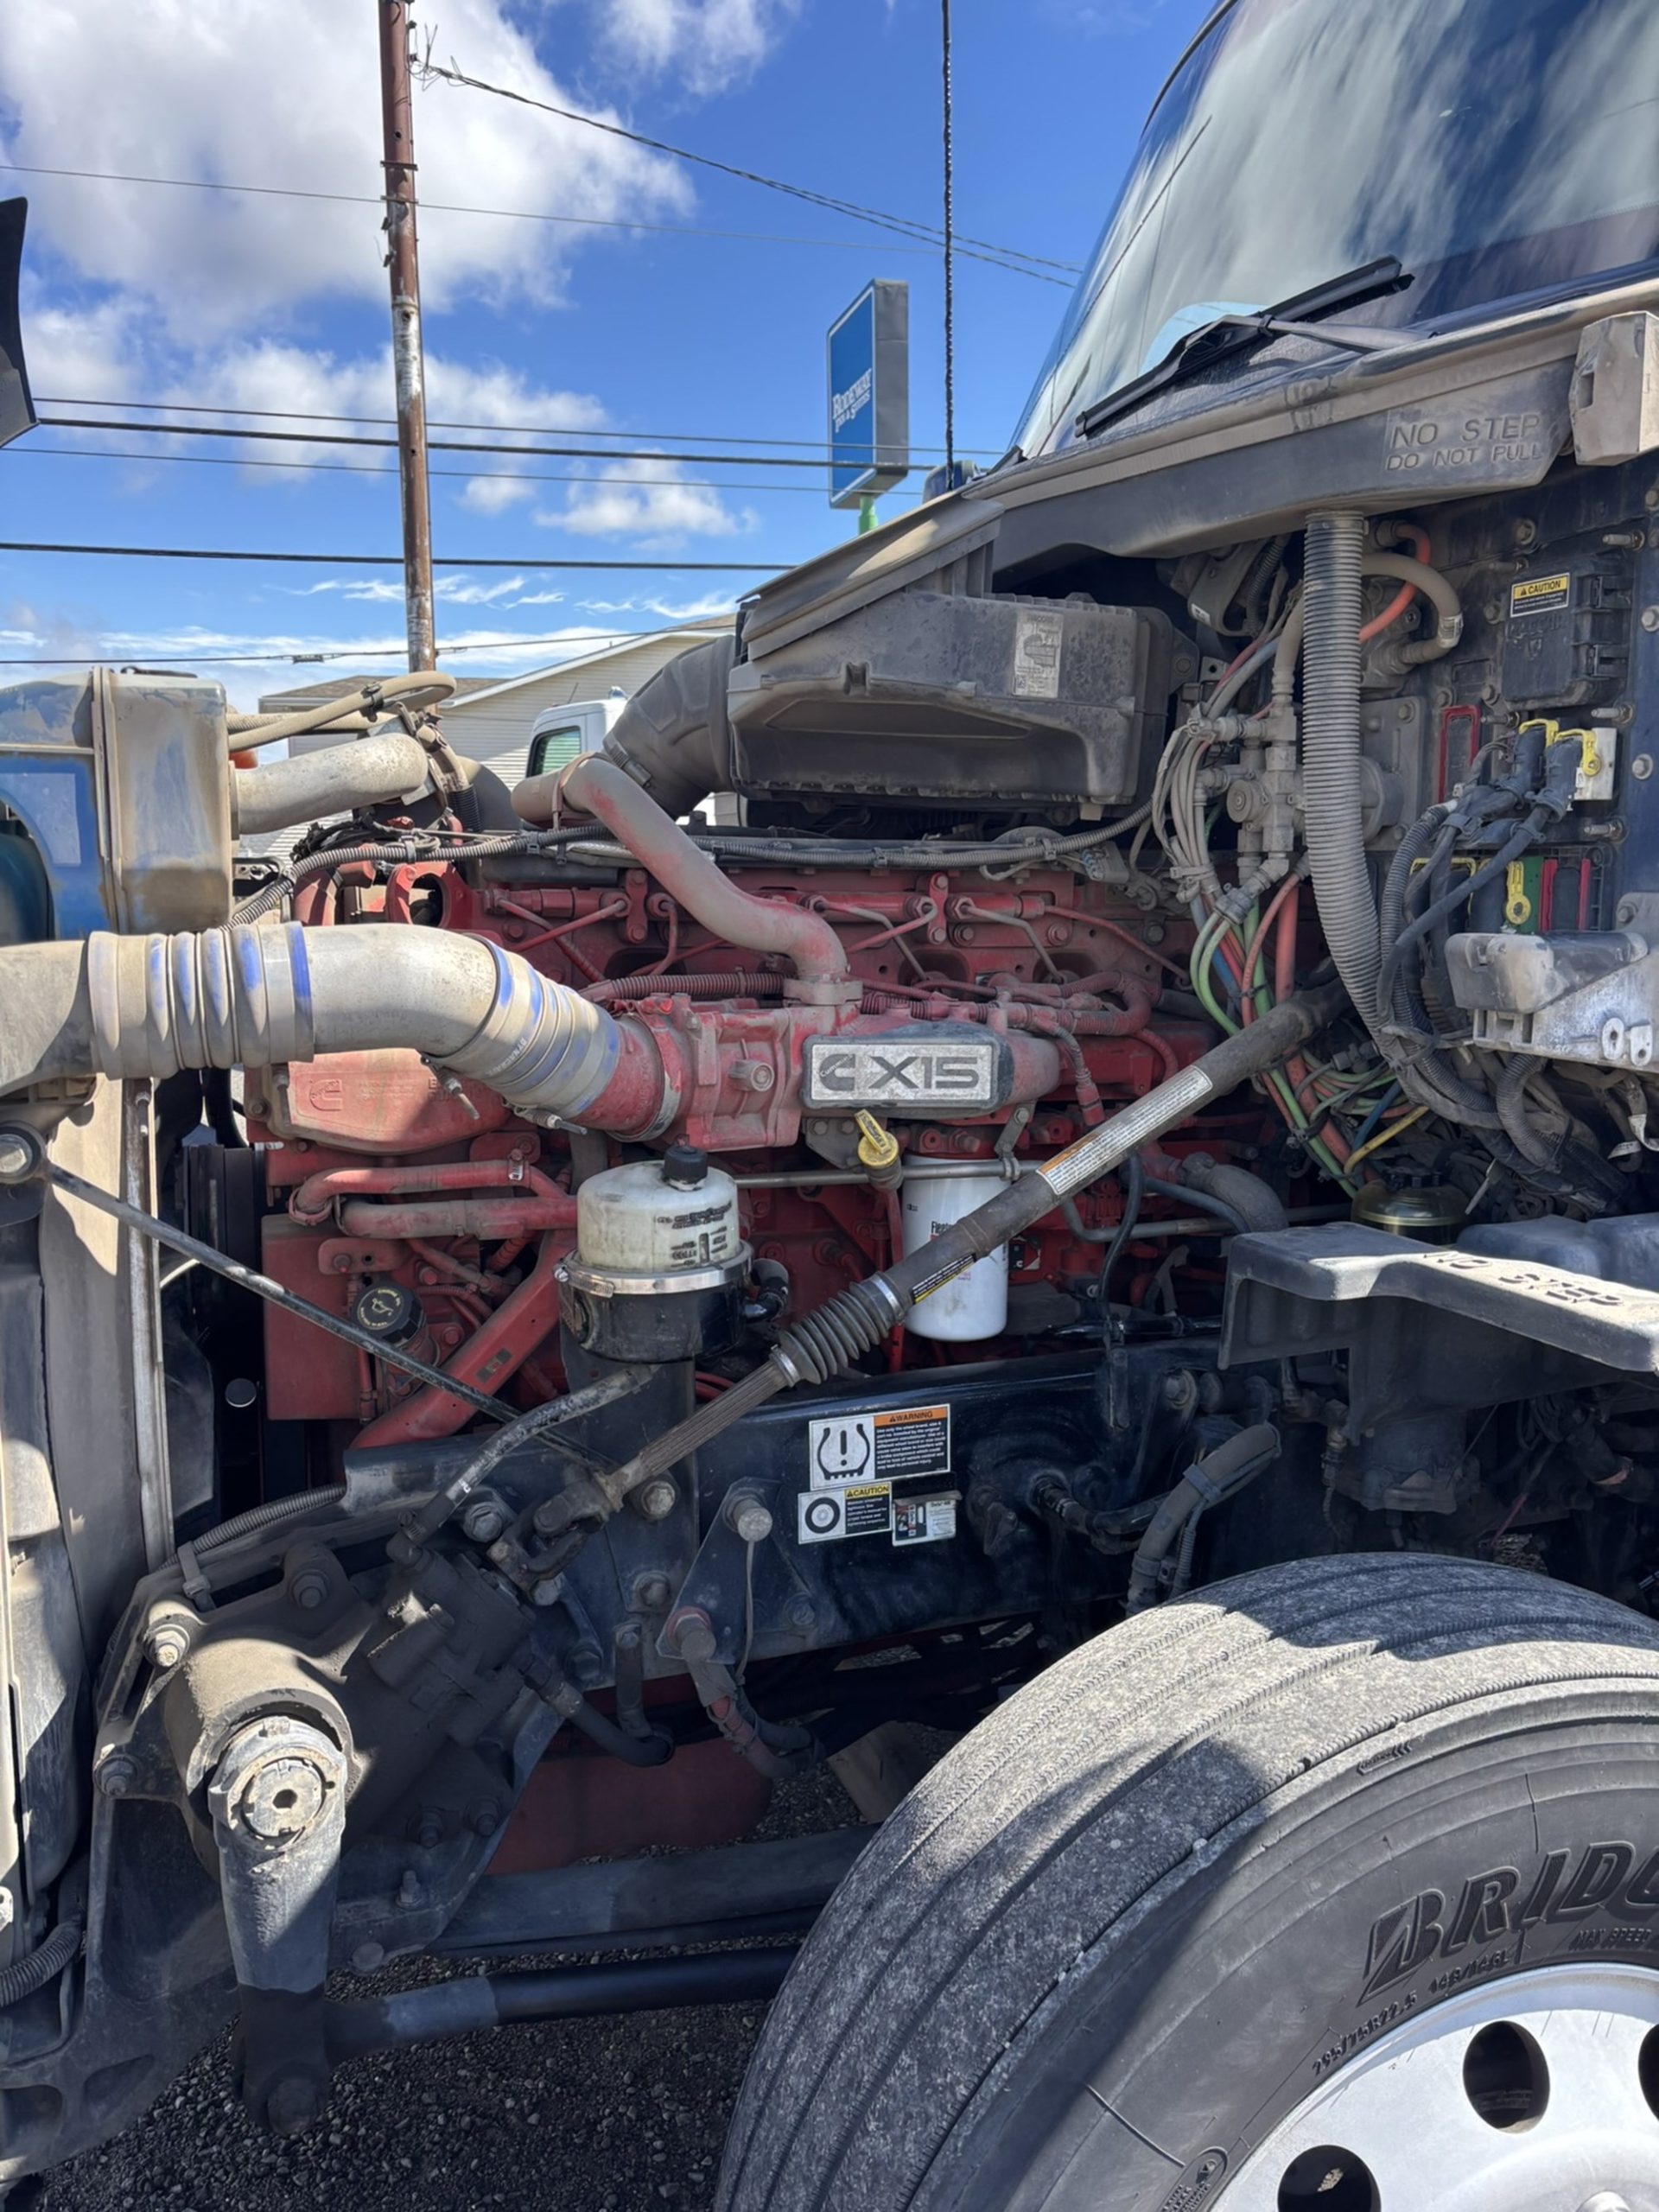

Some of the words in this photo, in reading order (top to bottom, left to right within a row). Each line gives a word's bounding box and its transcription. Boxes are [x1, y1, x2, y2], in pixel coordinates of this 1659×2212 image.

[1389, 423, 1439, 448] NO
[1461, 413, 1541, 442] STEP
[1385, 453, 1420, 472] DO
[1433, 446, 1478, 467] NOT
[1492, 442, 1542, 463] PULL
[1528, 579, 1561, 594] CAUTION
[867, 1055, 981, 1090] X15
[1423, 1251, 1493, 1269] NO
[1497, 1273, 1626, 1306] STEP
[896, 1410, 933, 1422] WARNING
[853, 1485, 889, 1497] CAUTION
